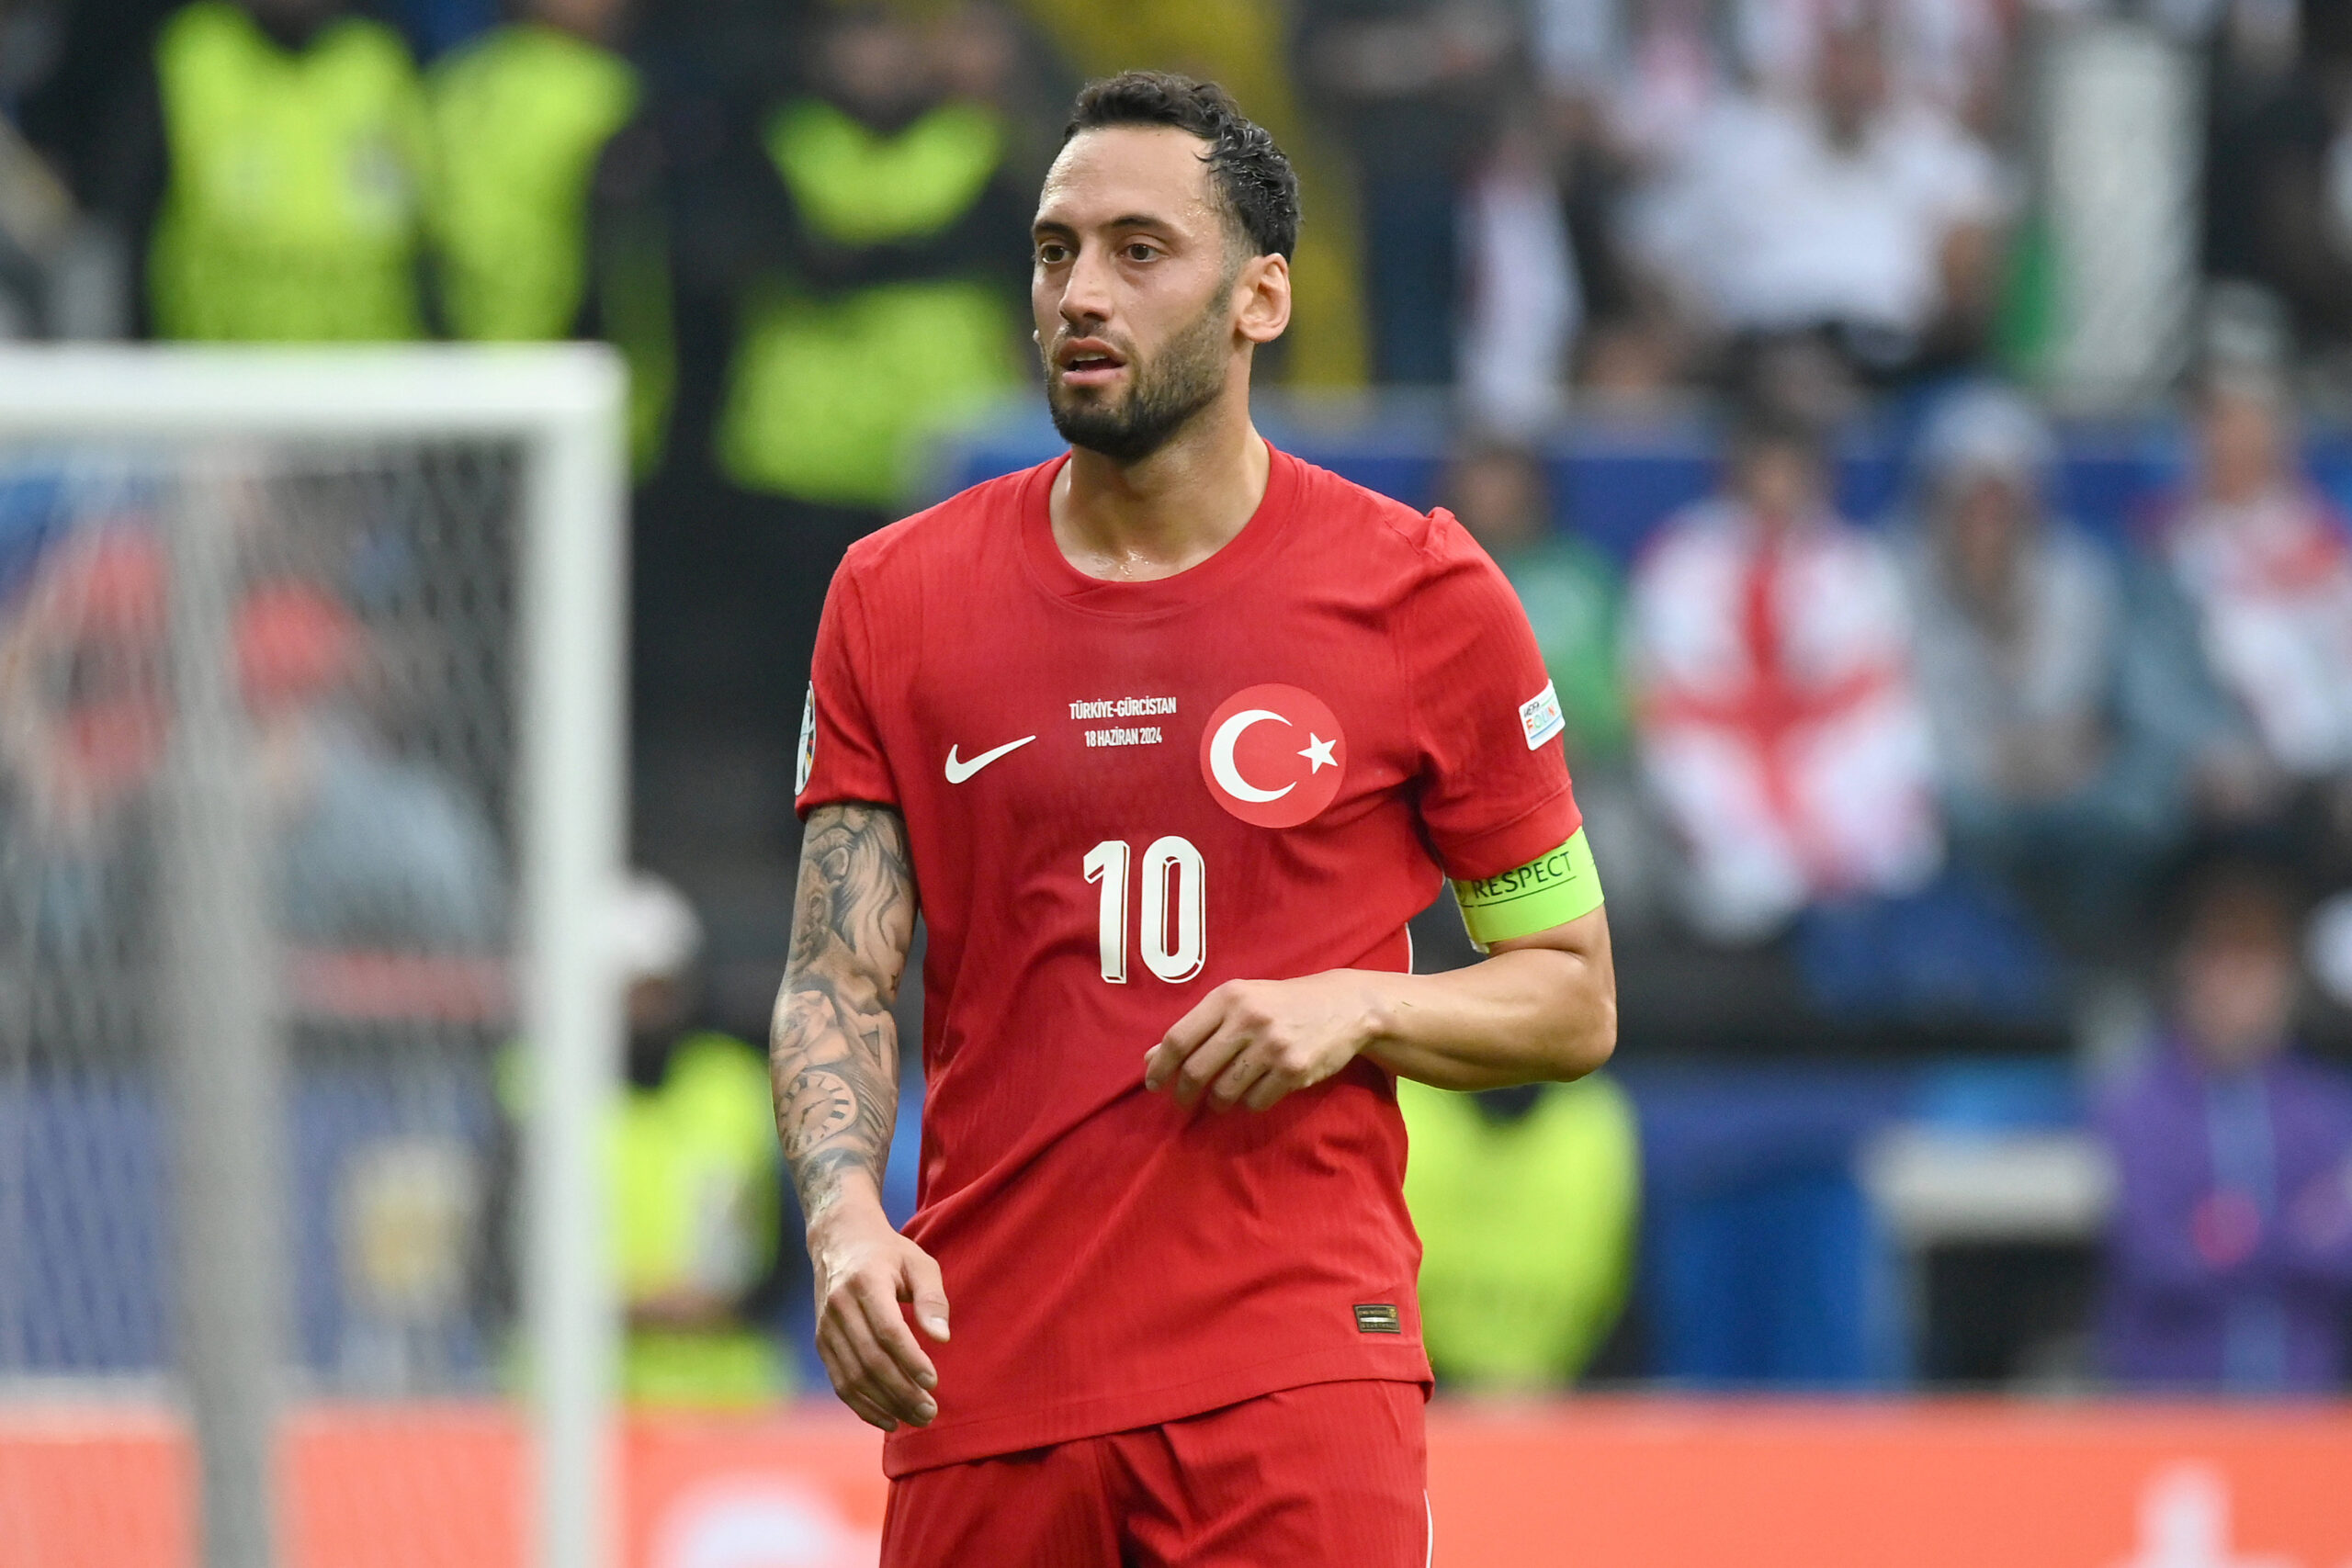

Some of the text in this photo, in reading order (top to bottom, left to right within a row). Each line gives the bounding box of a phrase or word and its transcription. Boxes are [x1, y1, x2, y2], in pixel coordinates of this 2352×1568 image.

[1084, 726, 1163, 747] 18 HAZİRAN 2024
[1471, 851, 1571, 899] RESPECT
[1083, 835, 1206, 984] 10
